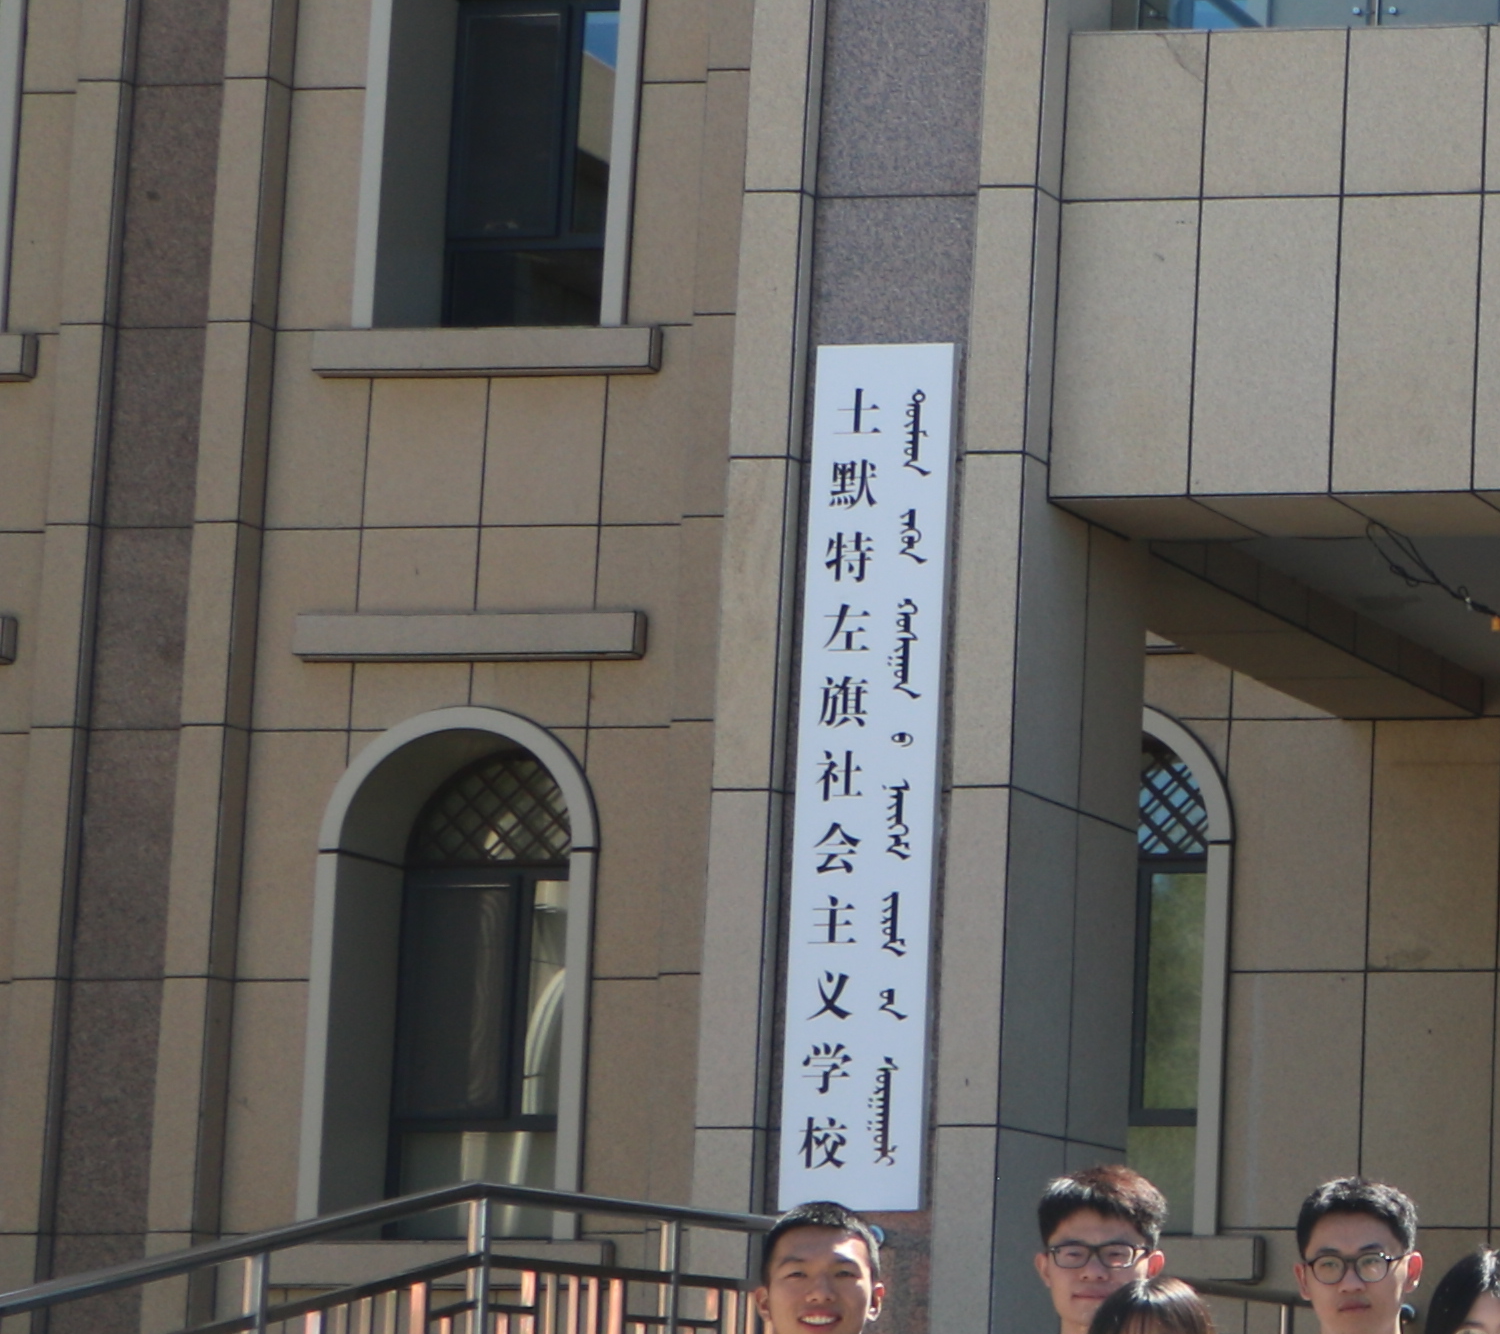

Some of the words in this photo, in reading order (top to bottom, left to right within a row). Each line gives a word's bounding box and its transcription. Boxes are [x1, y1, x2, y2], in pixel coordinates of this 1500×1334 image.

[798, 387, 882, 1170] 土默特左旗社会主义学校
